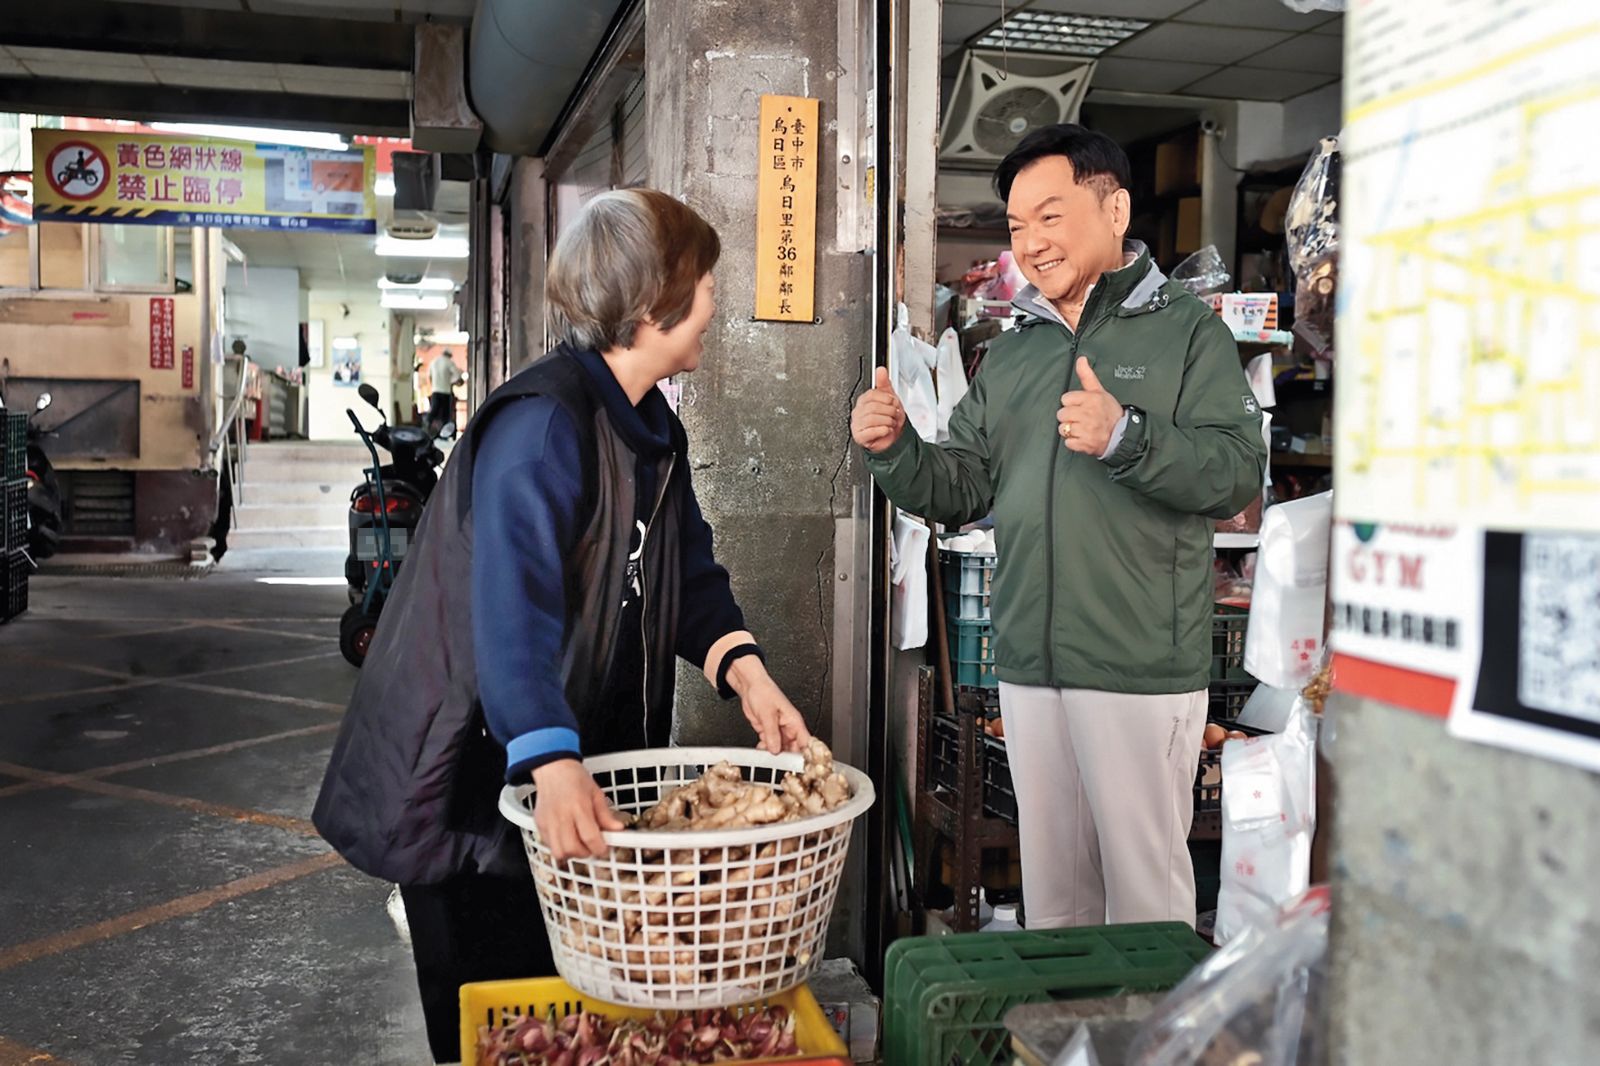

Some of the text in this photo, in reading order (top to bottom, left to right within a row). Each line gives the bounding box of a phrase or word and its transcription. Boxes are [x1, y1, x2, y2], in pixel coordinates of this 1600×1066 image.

[117, 143, 243, 172] 黃色網狀線
[771, 117, 787, 170] 烏日區
[790, 118, 806, 171] 臺中市
[117, 174, 243, 206] 禁止臨停
[777, 175, 797, 315] 烏日里第36鄰鄰長
